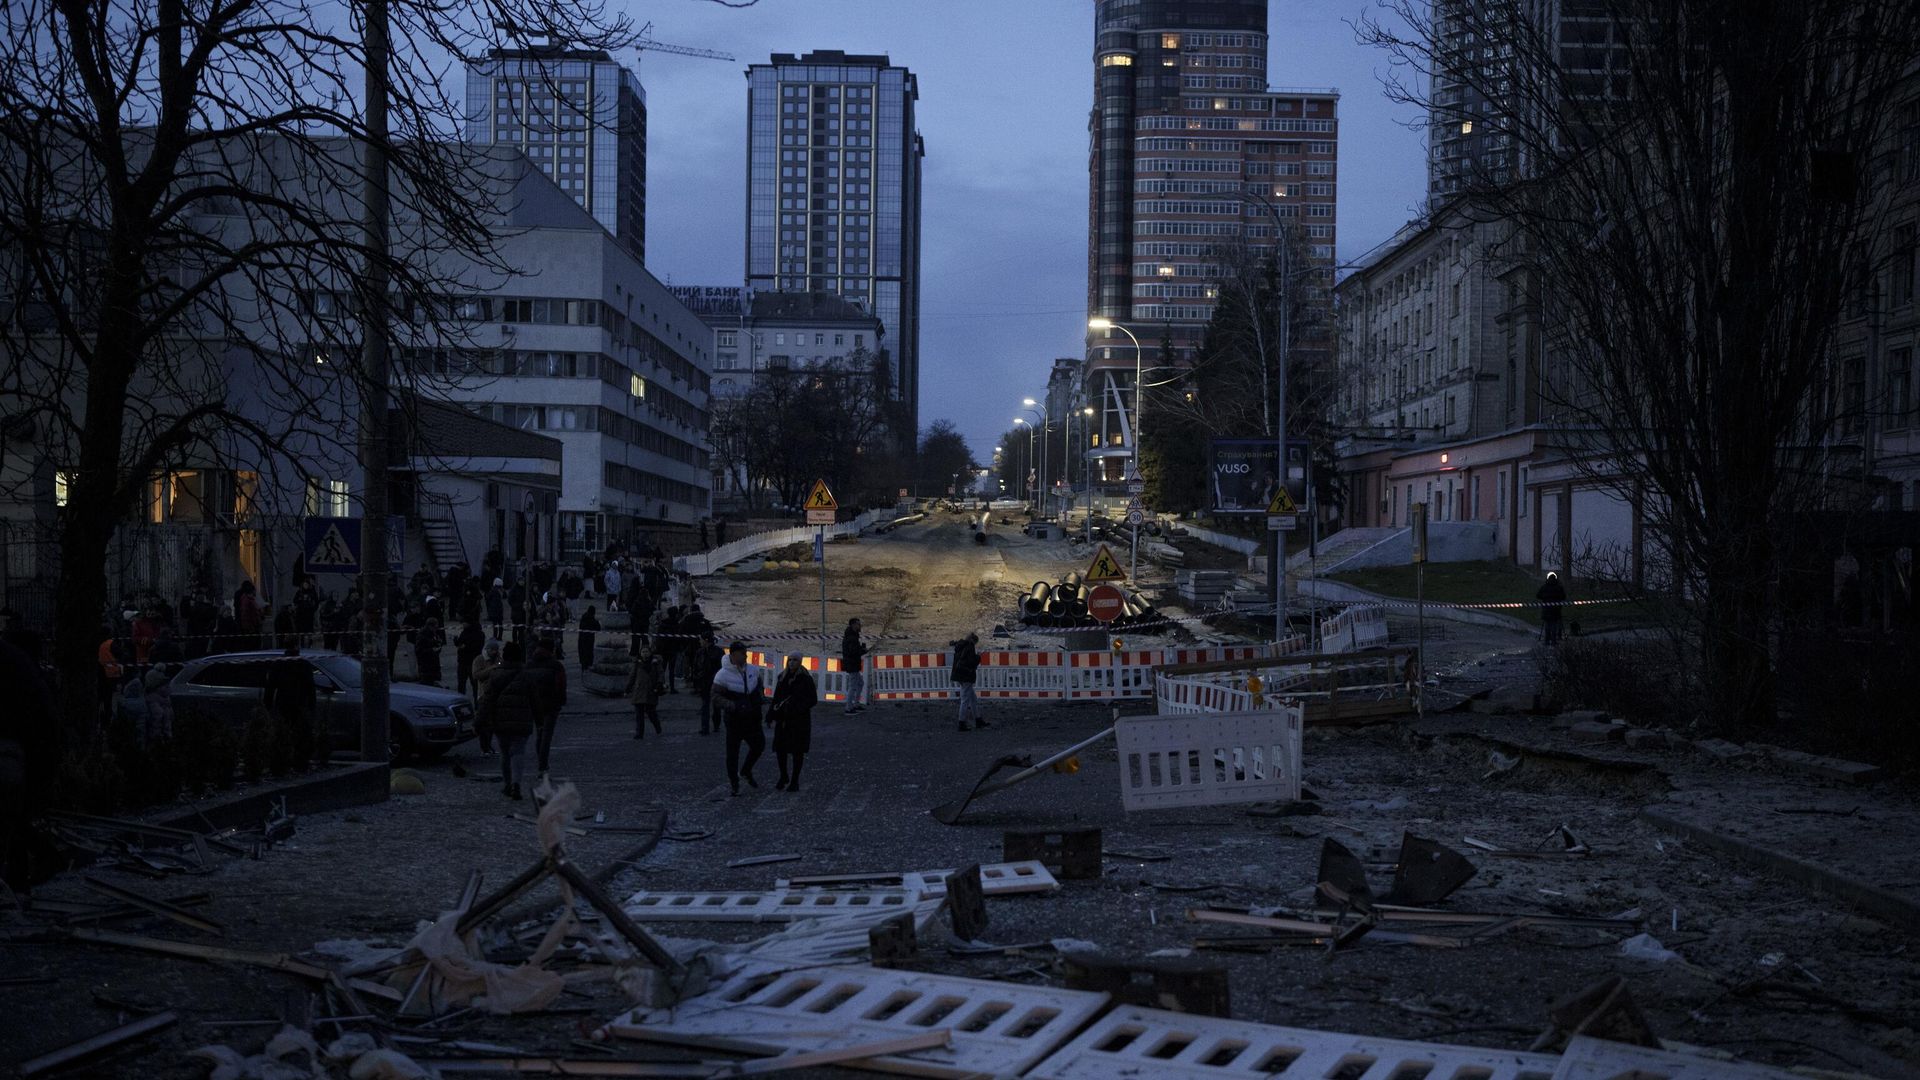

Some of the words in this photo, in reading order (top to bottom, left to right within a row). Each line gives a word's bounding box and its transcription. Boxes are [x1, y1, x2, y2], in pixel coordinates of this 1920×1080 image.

[705, 287, 741, 297] БАНК
[1217, 463, 1250, 474] VUSO
[1132, 514, 1141, 522] 30
